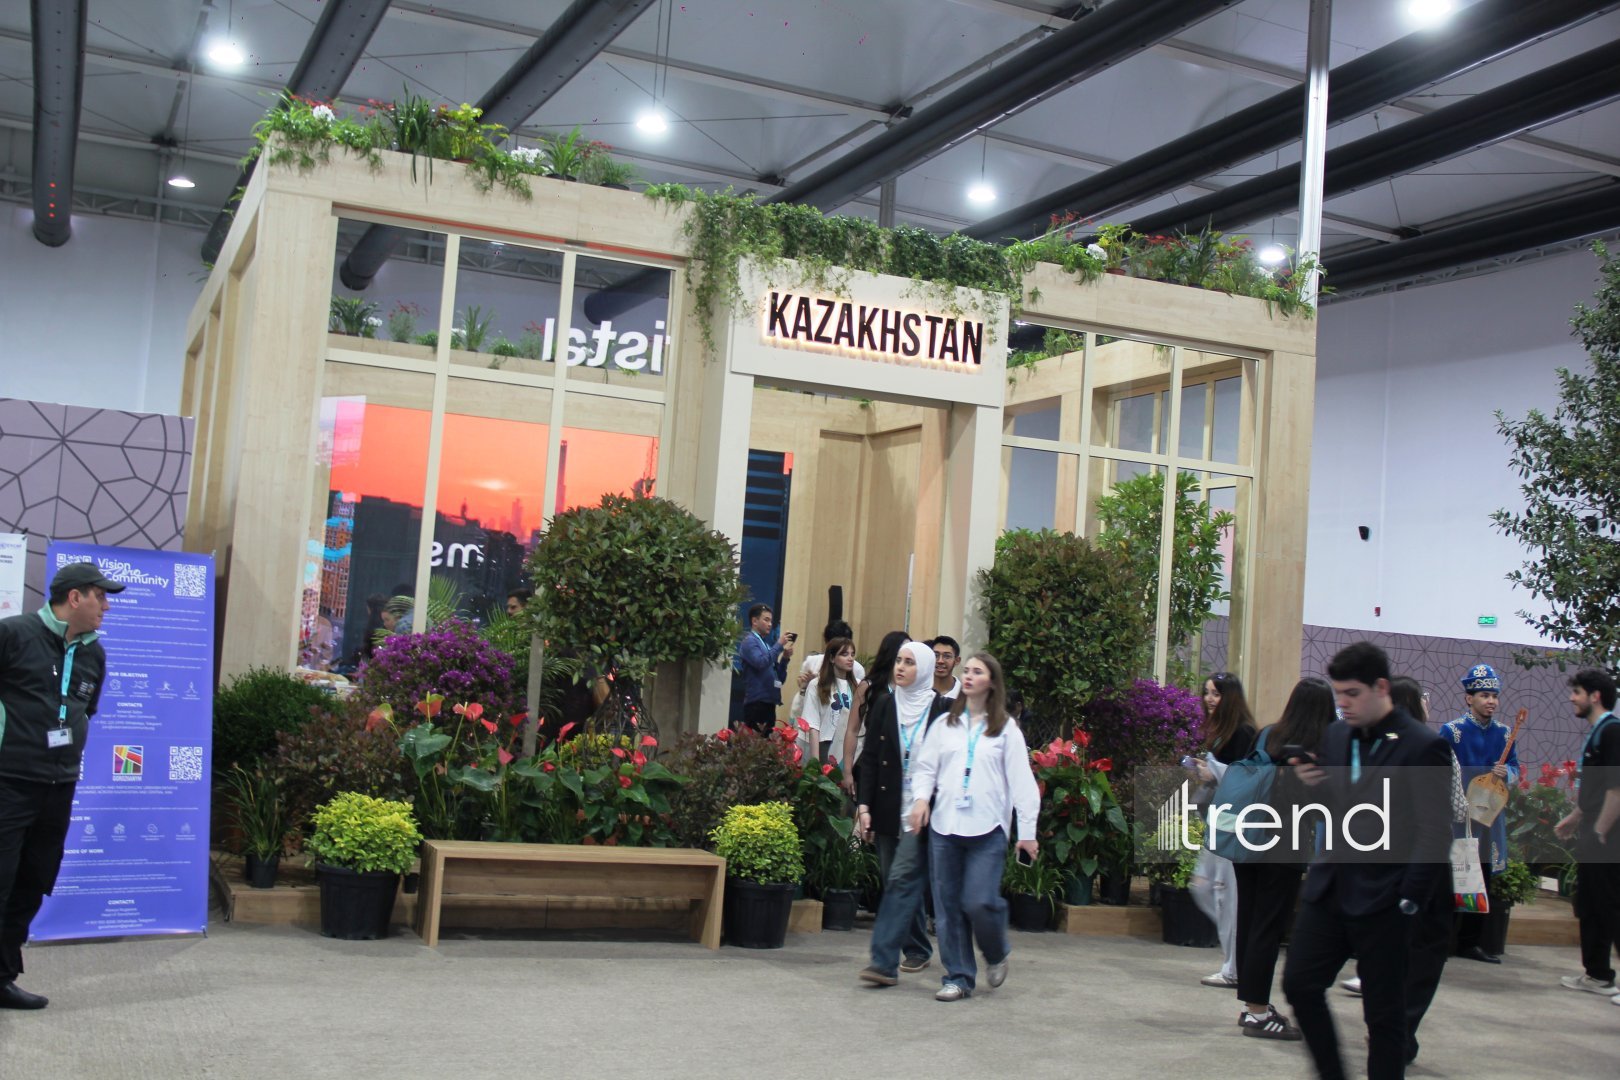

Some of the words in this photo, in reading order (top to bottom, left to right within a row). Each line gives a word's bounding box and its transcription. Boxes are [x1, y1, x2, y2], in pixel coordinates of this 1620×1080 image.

[769, 291, 983, 365] KAZAKHSTAN
[97, 557, 131, 570] Vision
[103, 572, 169, 588] Community
